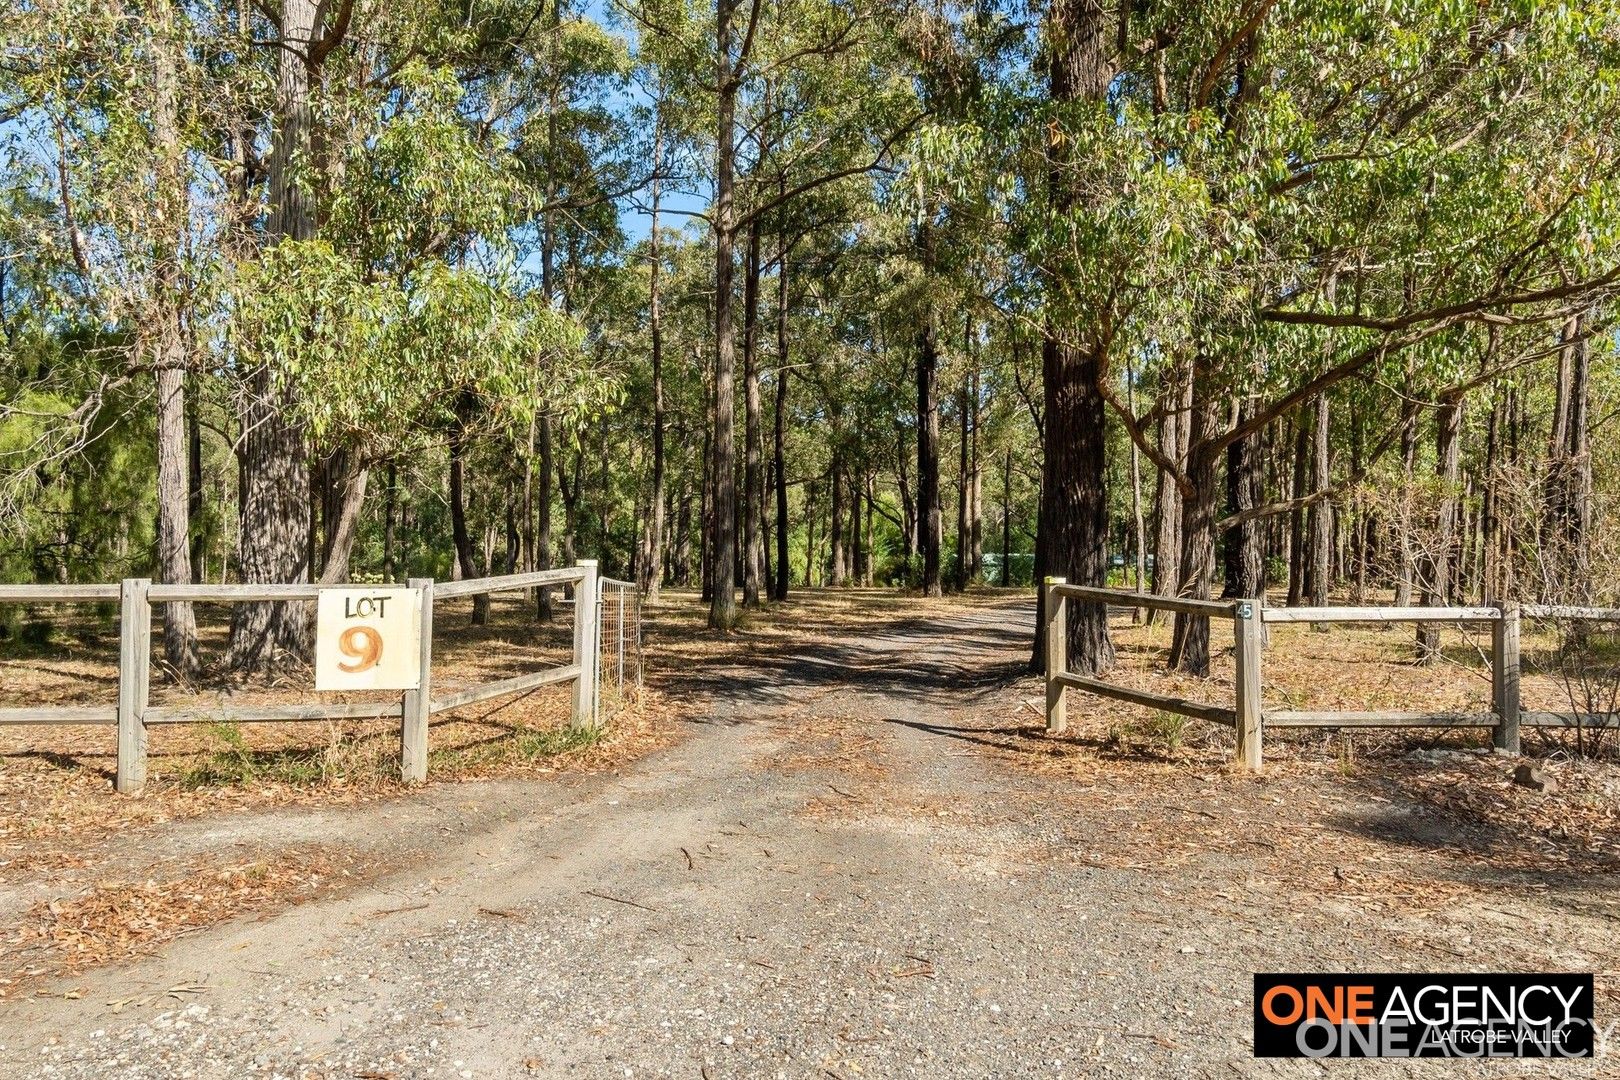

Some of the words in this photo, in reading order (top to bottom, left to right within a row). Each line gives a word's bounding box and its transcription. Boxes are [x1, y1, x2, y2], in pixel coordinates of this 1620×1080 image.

[345, 596, 391, 618] LOT
[1237, 603, 1252, 618] 45
[337, 626, 383, 673] 9
